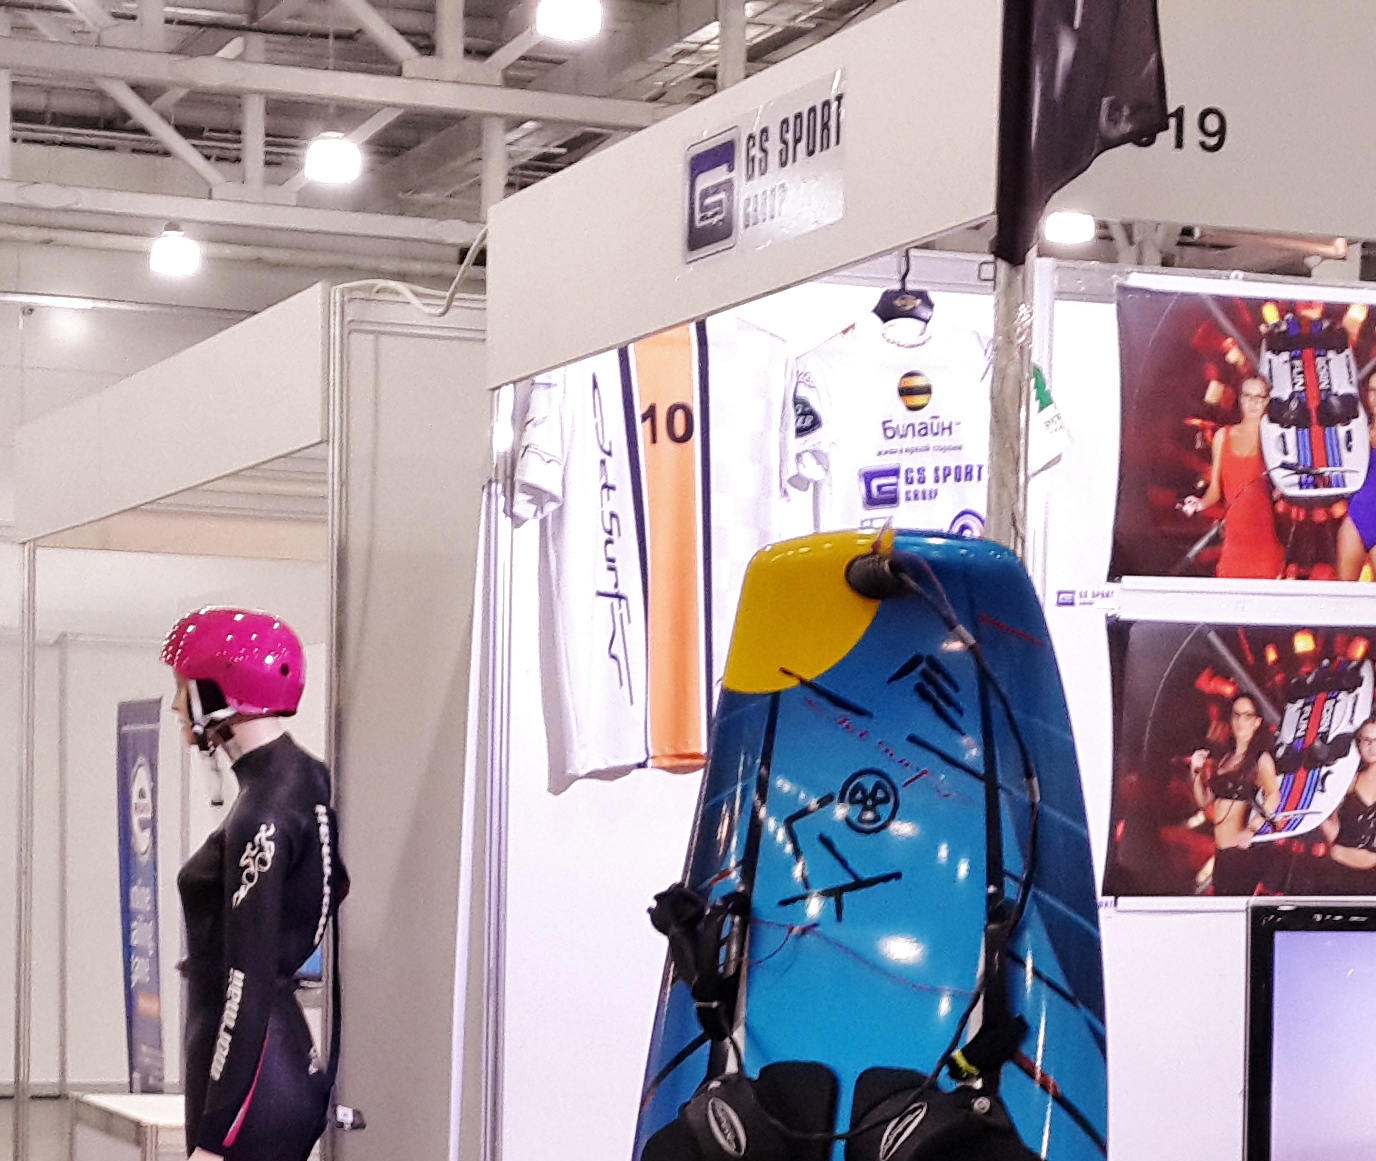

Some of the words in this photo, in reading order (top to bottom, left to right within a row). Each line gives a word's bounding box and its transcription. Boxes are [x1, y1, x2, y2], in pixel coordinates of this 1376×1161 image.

[745, 131, 770, 182] GS
[779, 92, 844, 168] SPORT
[641, 402, 695, 444] 10
[904, 466, 927, 485] GS
[933, 464, 984, 484] SPORT
